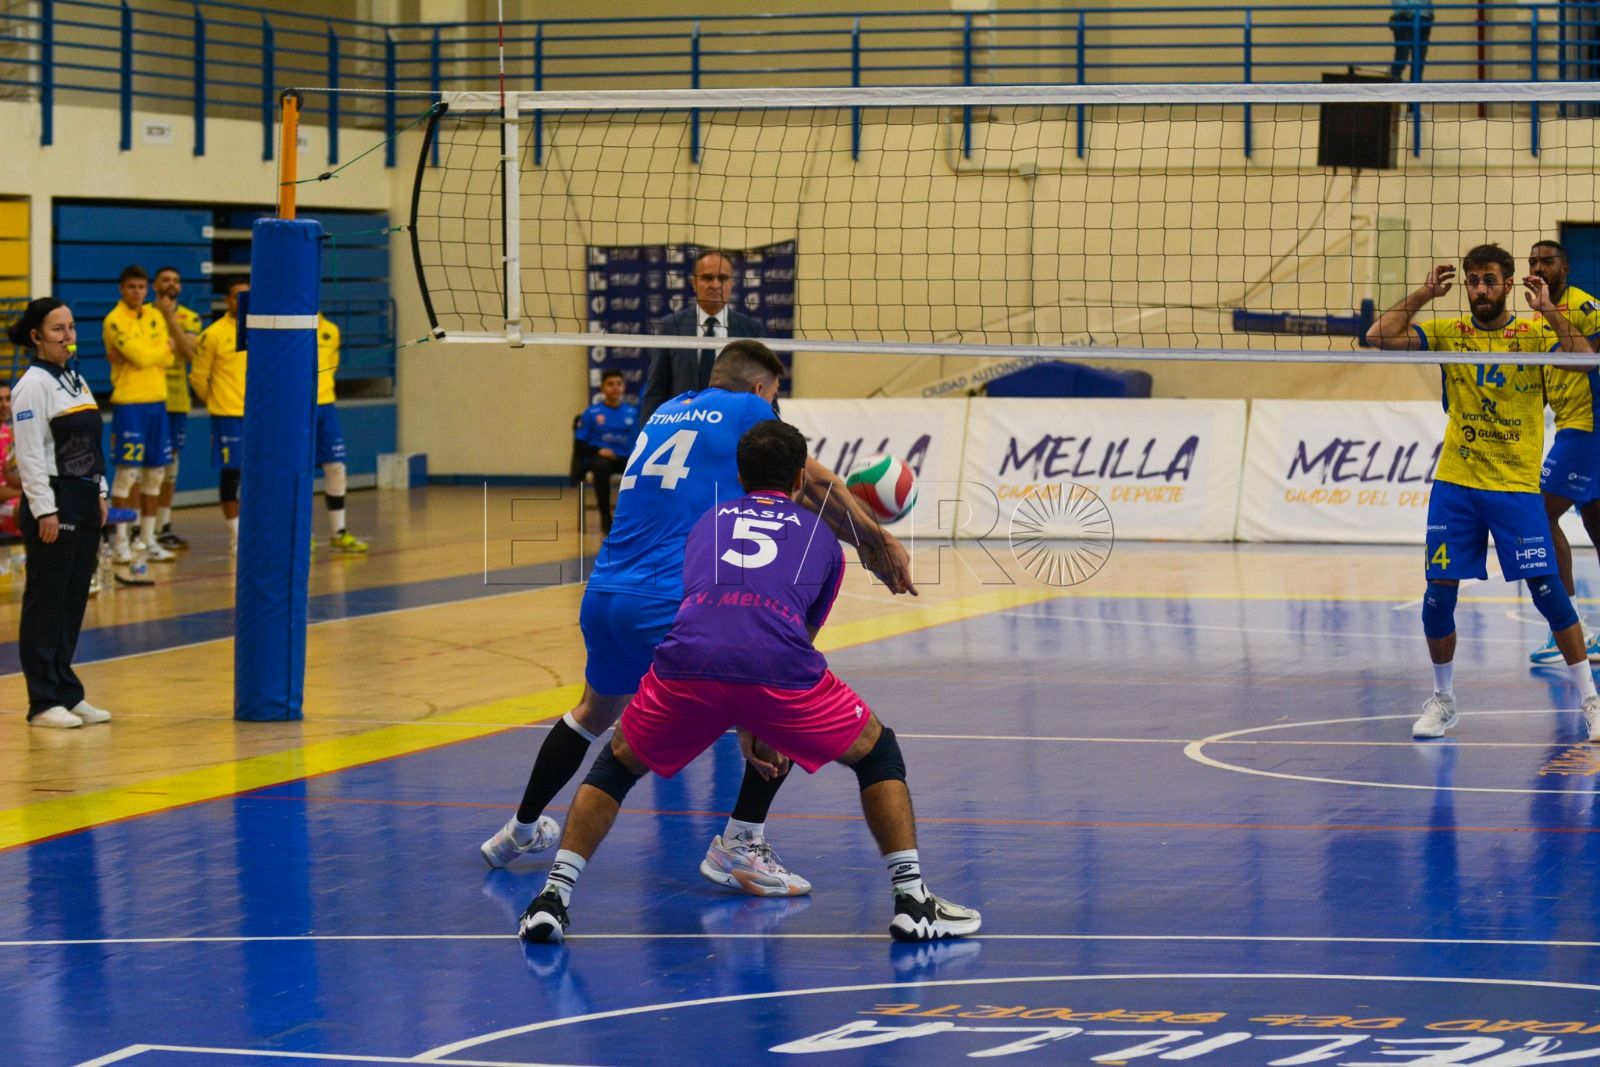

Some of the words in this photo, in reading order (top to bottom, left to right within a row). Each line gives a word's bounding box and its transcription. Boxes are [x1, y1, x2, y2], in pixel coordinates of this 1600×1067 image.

[1478, 429, 1520, 442] GUAGUAS
[122, 443, 145, 461] 22
[618, 429, 698, 491] 24
[998, 434, 1200, 482] MELILLA
[1286, 437, 1444, 485] MELILL
[1110, 485, 1187, 503] DEPORTE
[1285, 488, 1351, 505] CIUDAD
[1358, 490, 1389, 506] DEL
[717, 506, 802, 527] MASIÀ
[720, 517, 785, 569] 5
[1515, 547, 1547, 561] HPS
[717, 591, 801, 626] MELILLA
